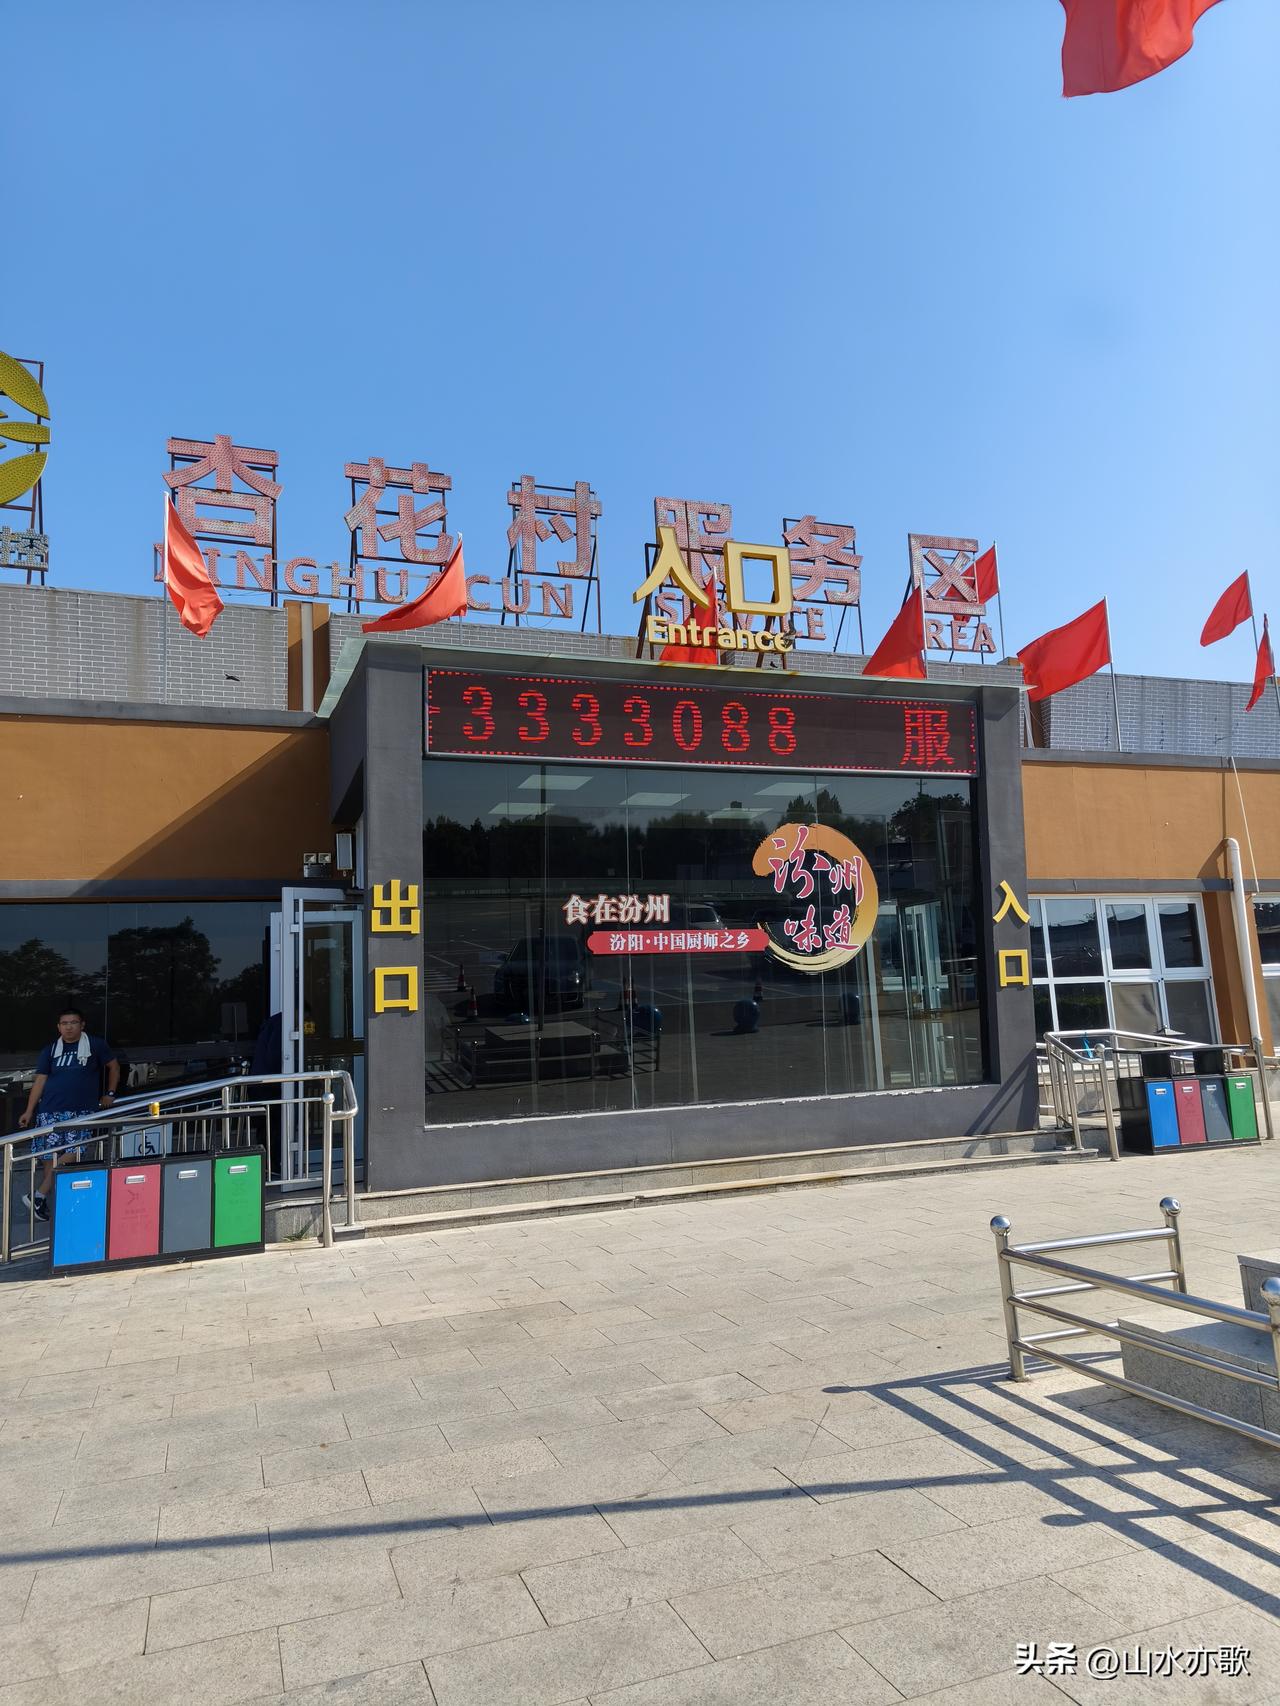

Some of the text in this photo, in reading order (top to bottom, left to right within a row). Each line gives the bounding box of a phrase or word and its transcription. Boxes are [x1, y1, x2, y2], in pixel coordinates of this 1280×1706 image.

[153, 543, 574, 618] INGHUCUN
[924, 618, 997, 653] REA
[633, 526, 794, 616] 入口
[647, 615, 795, 652] Entrance
[899, 706, 954, 768] 服
[768, 825, 864, 905] 汾州
[563, 893, 670, 925] 食在汾州
[609, 932, 751, 951] 汾阳·中国厨师之乡
[783, 904, 861, 953] 味道
[993, 880, 1031, 987] 入口
[371, 879, 421, 1013] 出口
